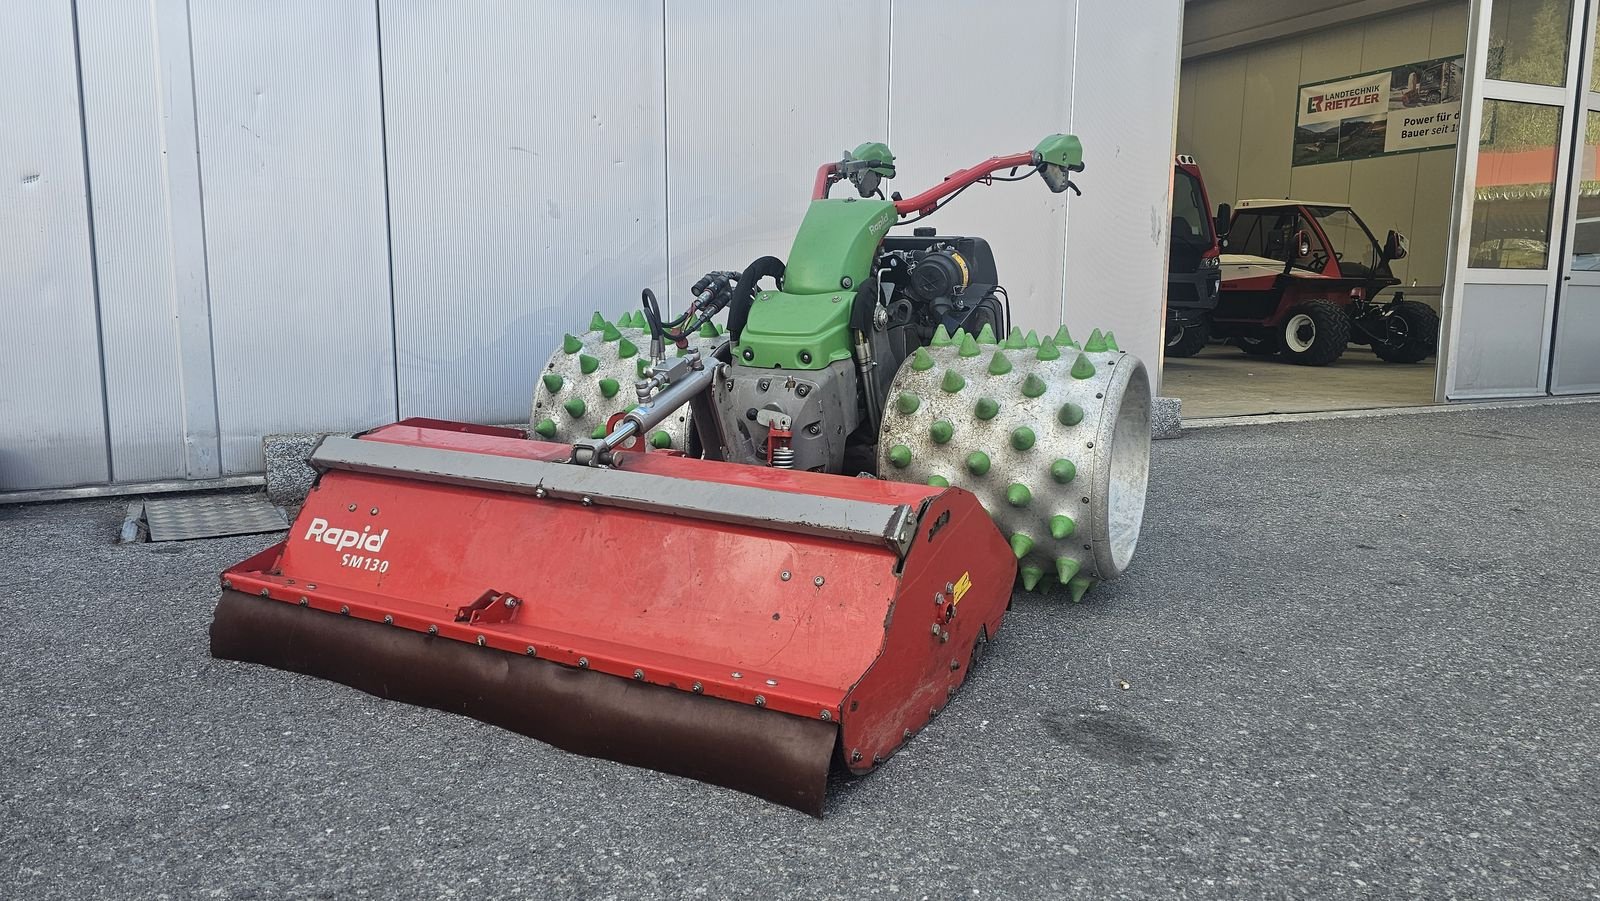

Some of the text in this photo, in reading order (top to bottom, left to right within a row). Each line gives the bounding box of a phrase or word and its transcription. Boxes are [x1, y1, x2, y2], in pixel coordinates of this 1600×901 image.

[1325, 85, 1380, 101] LANDTECHNIK
[1324, 93, 1380, 111] RIETZLER
[1403, 116, 1434, 126] Power
[1436, 112, 1452, 122] für
[1401, 128, 1430, 139] Bauer
[1431, 124, 1449, 135] seit
[304, 517, 389, 552] Rapid
